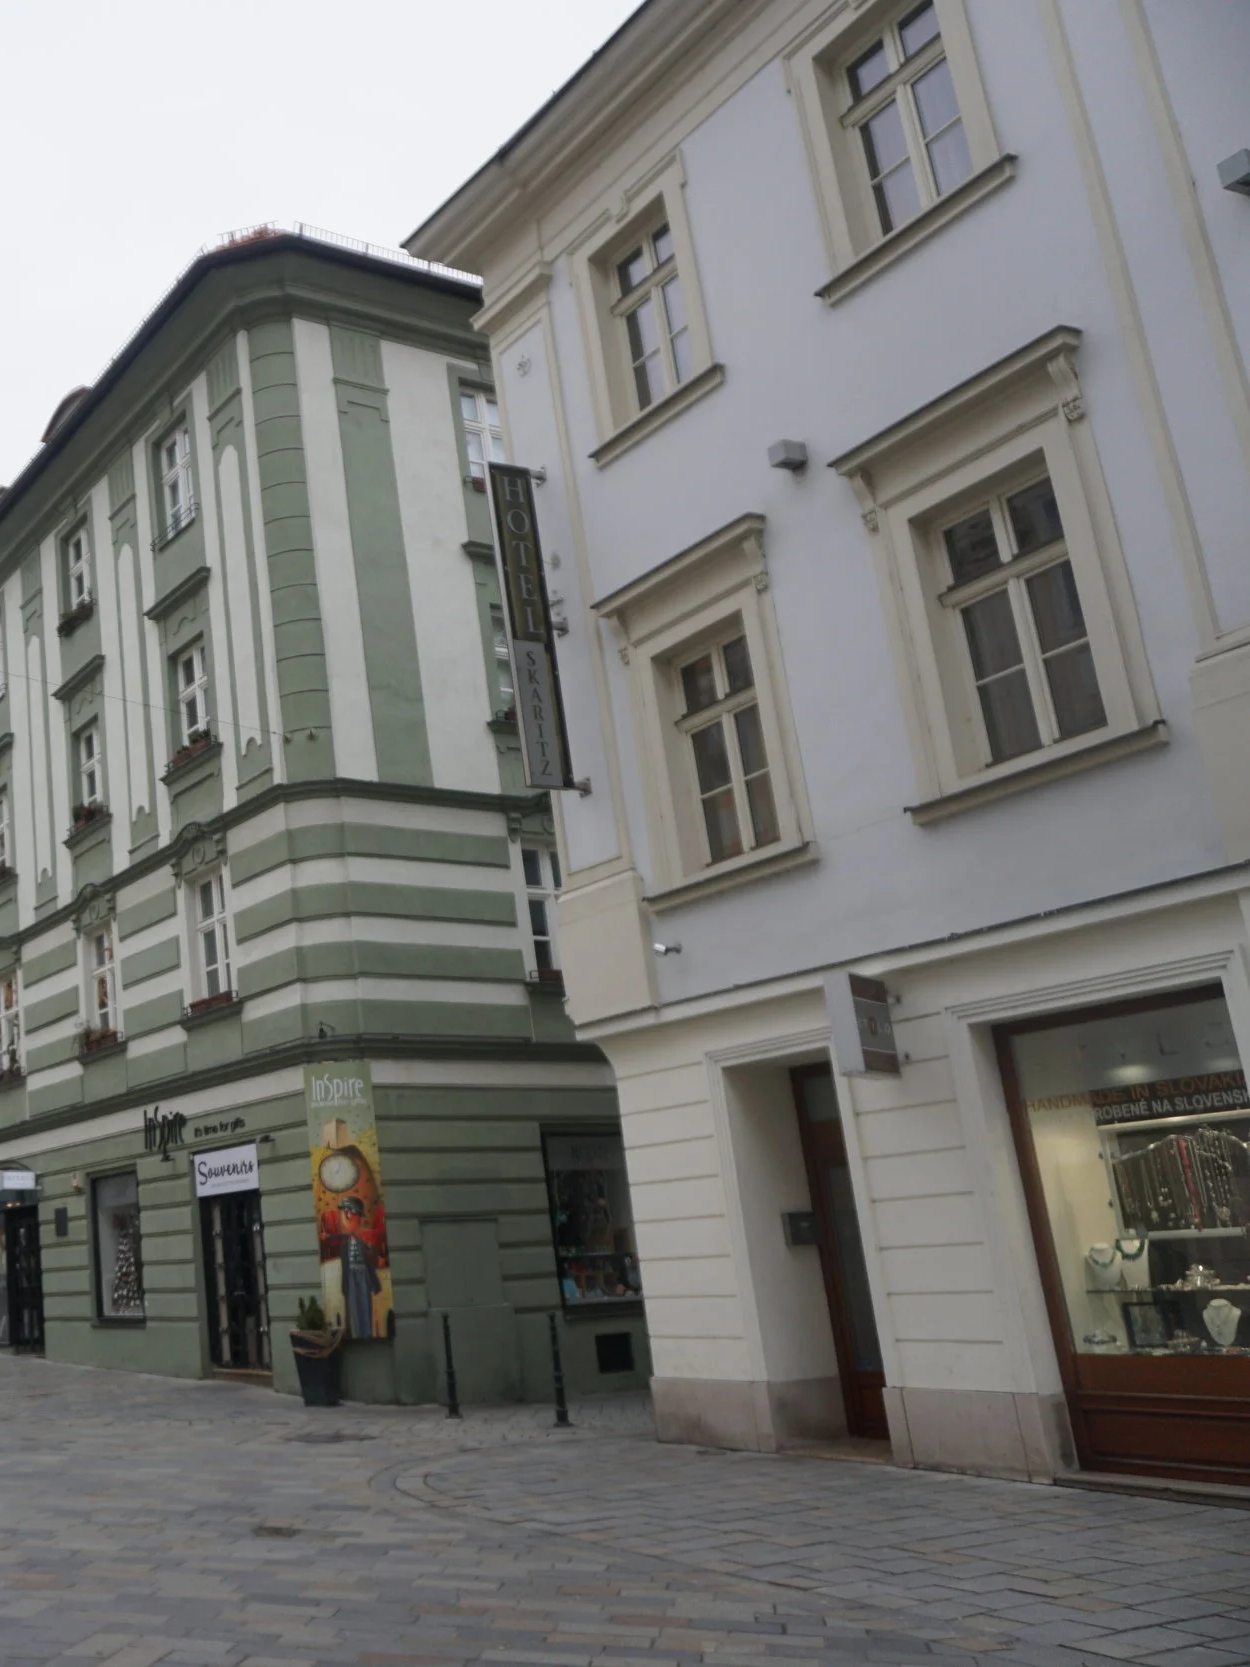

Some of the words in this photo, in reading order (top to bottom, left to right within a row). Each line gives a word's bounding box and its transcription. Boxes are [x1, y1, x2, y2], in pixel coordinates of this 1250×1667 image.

[502, 475, 543, 635] HOTEL
[525, 650, 553, 777] SKARITZ
[1131, 1082, 1150, 1101] IN
[1156, 1071, 1244, 1097] SLOVAKI
[1152, 1098, 1172, 1115] NA
[197, 1160, 255, 1186] Souvenirs
